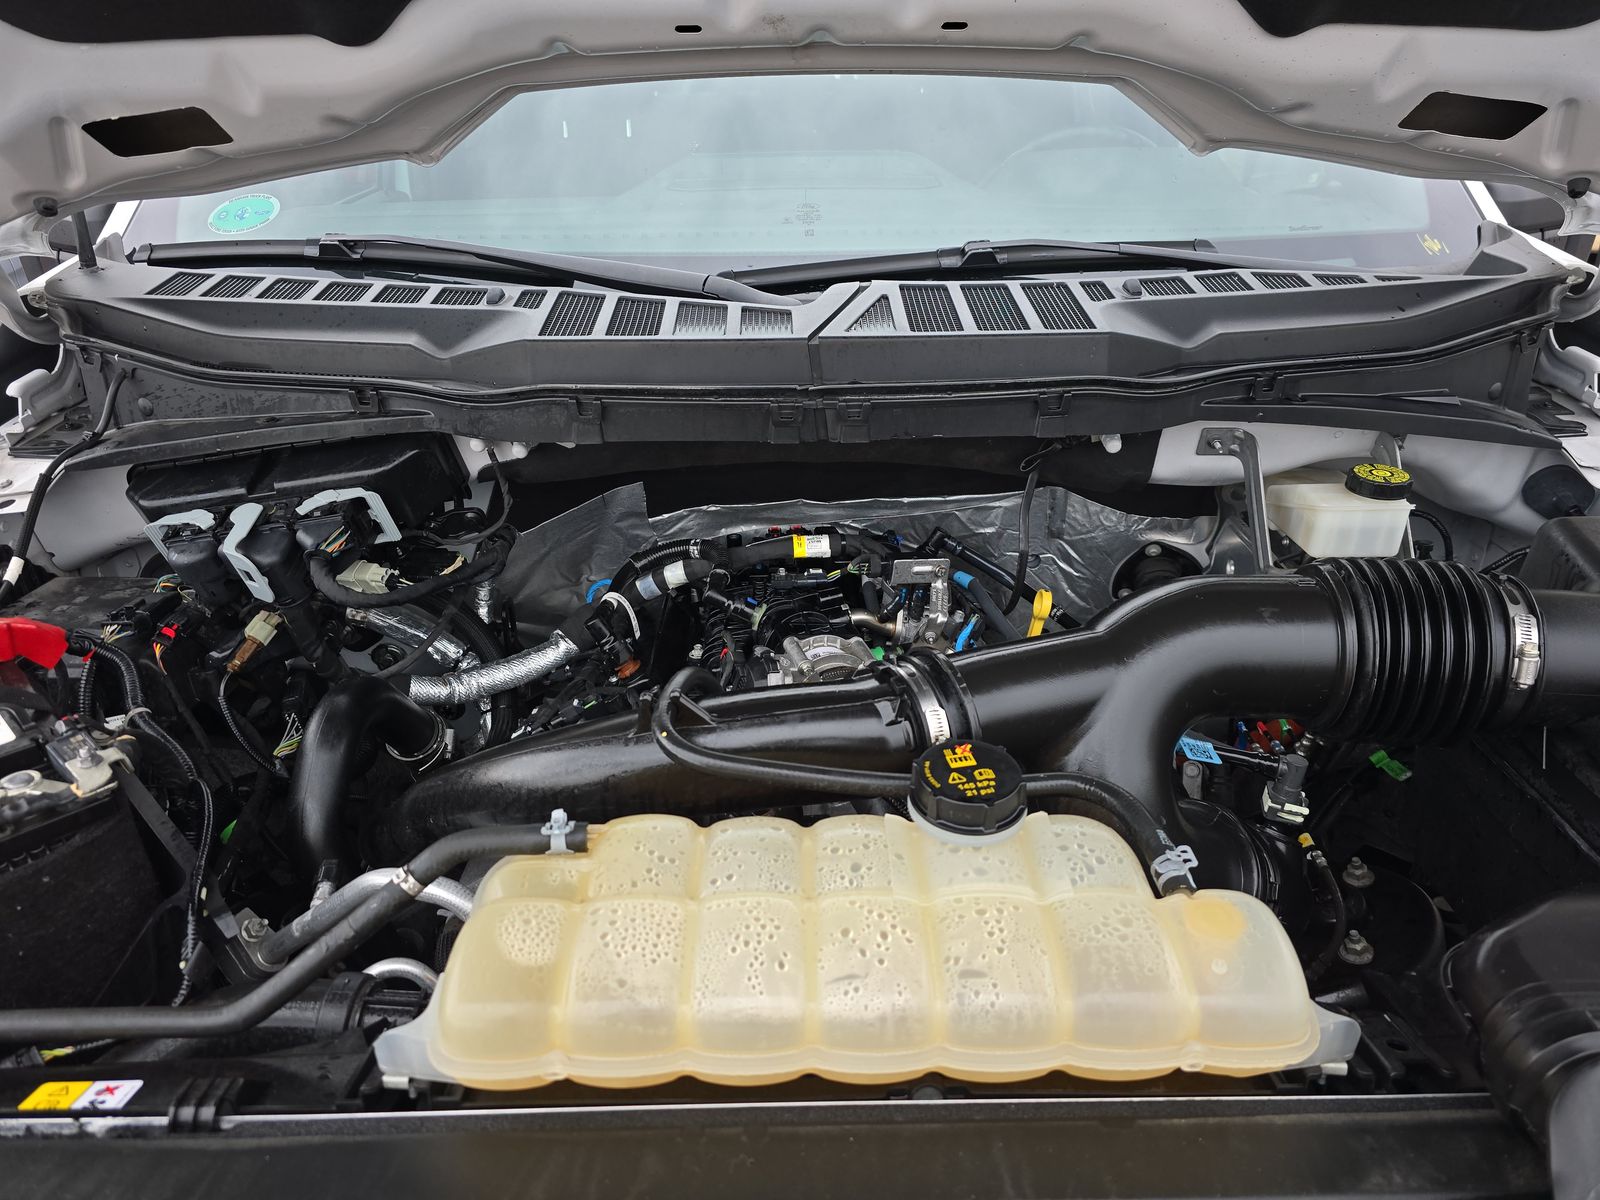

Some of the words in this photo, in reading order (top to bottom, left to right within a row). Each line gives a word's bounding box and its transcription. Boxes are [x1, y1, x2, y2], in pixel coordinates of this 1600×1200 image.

[957, 782, 976, 791] 145
[976, 780, 996, 788] kPa
[965, 789, 978, 797] 21
[979, 787, 995, 796] psi
